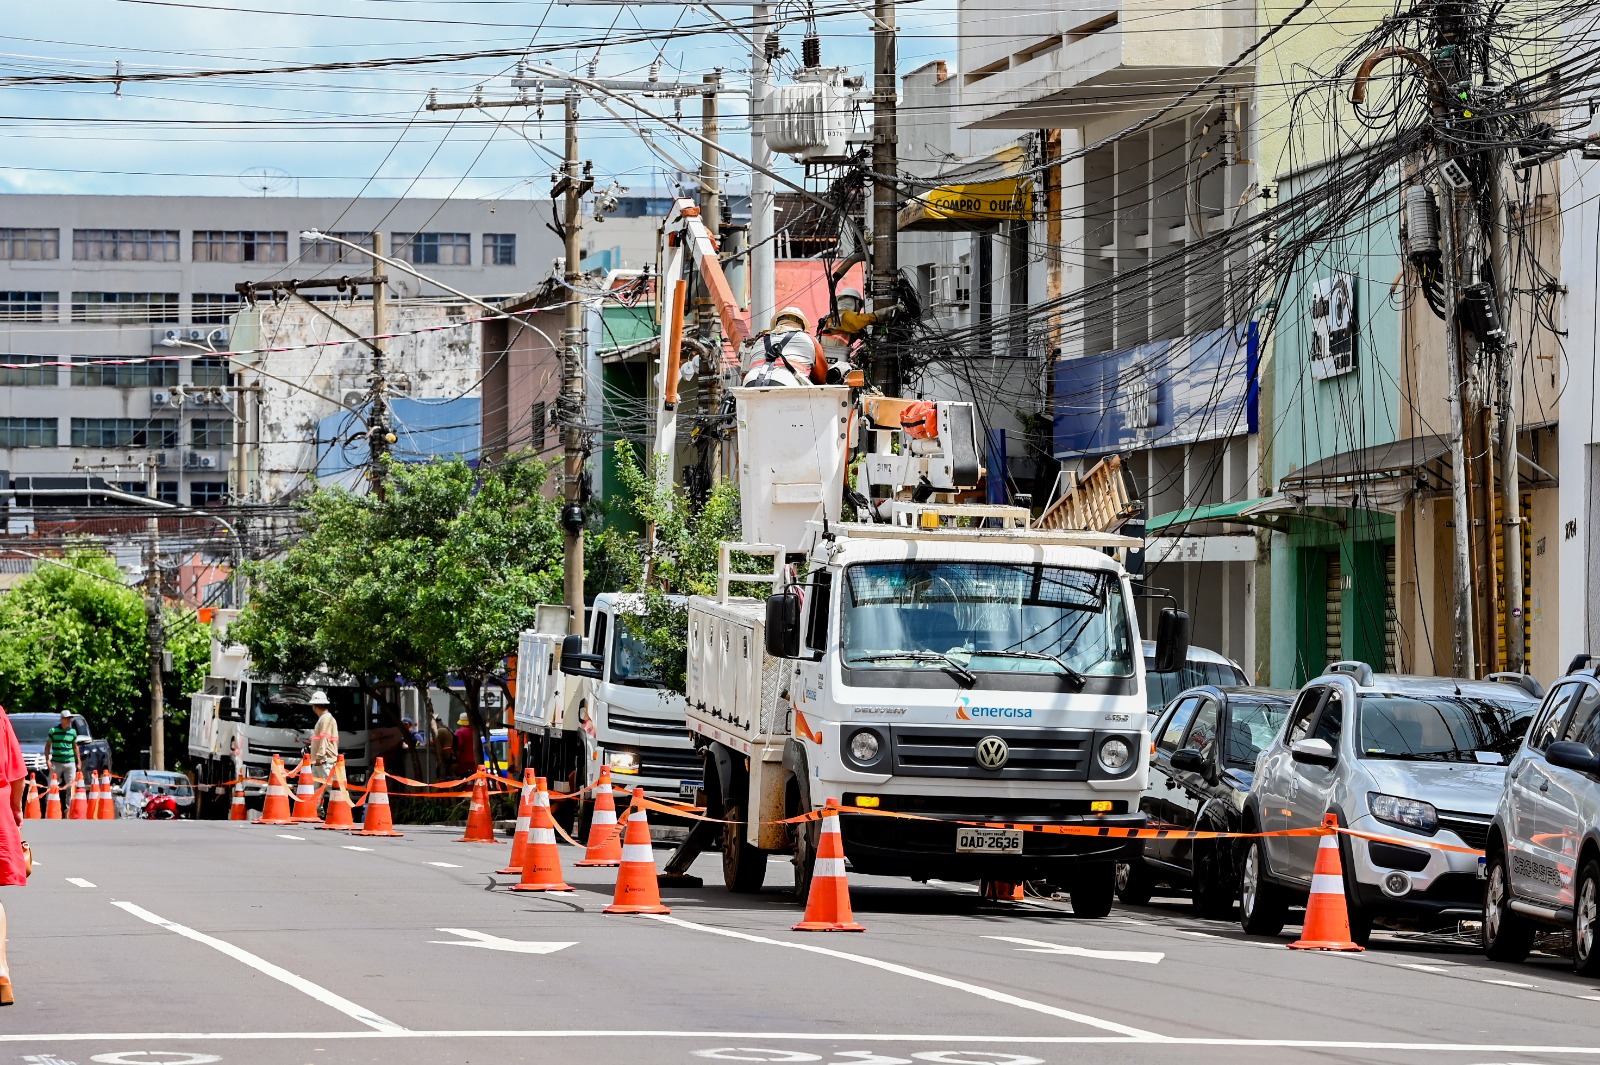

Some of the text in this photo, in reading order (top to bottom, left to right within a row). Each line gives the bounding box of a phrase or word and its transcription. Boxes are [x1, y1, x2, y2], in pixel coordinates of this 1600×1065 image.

[935, 199, 982, 212] COMPRO
[854, 706, 908, 715] DELIVERY
[971, 706, 1033, 718] energisa
